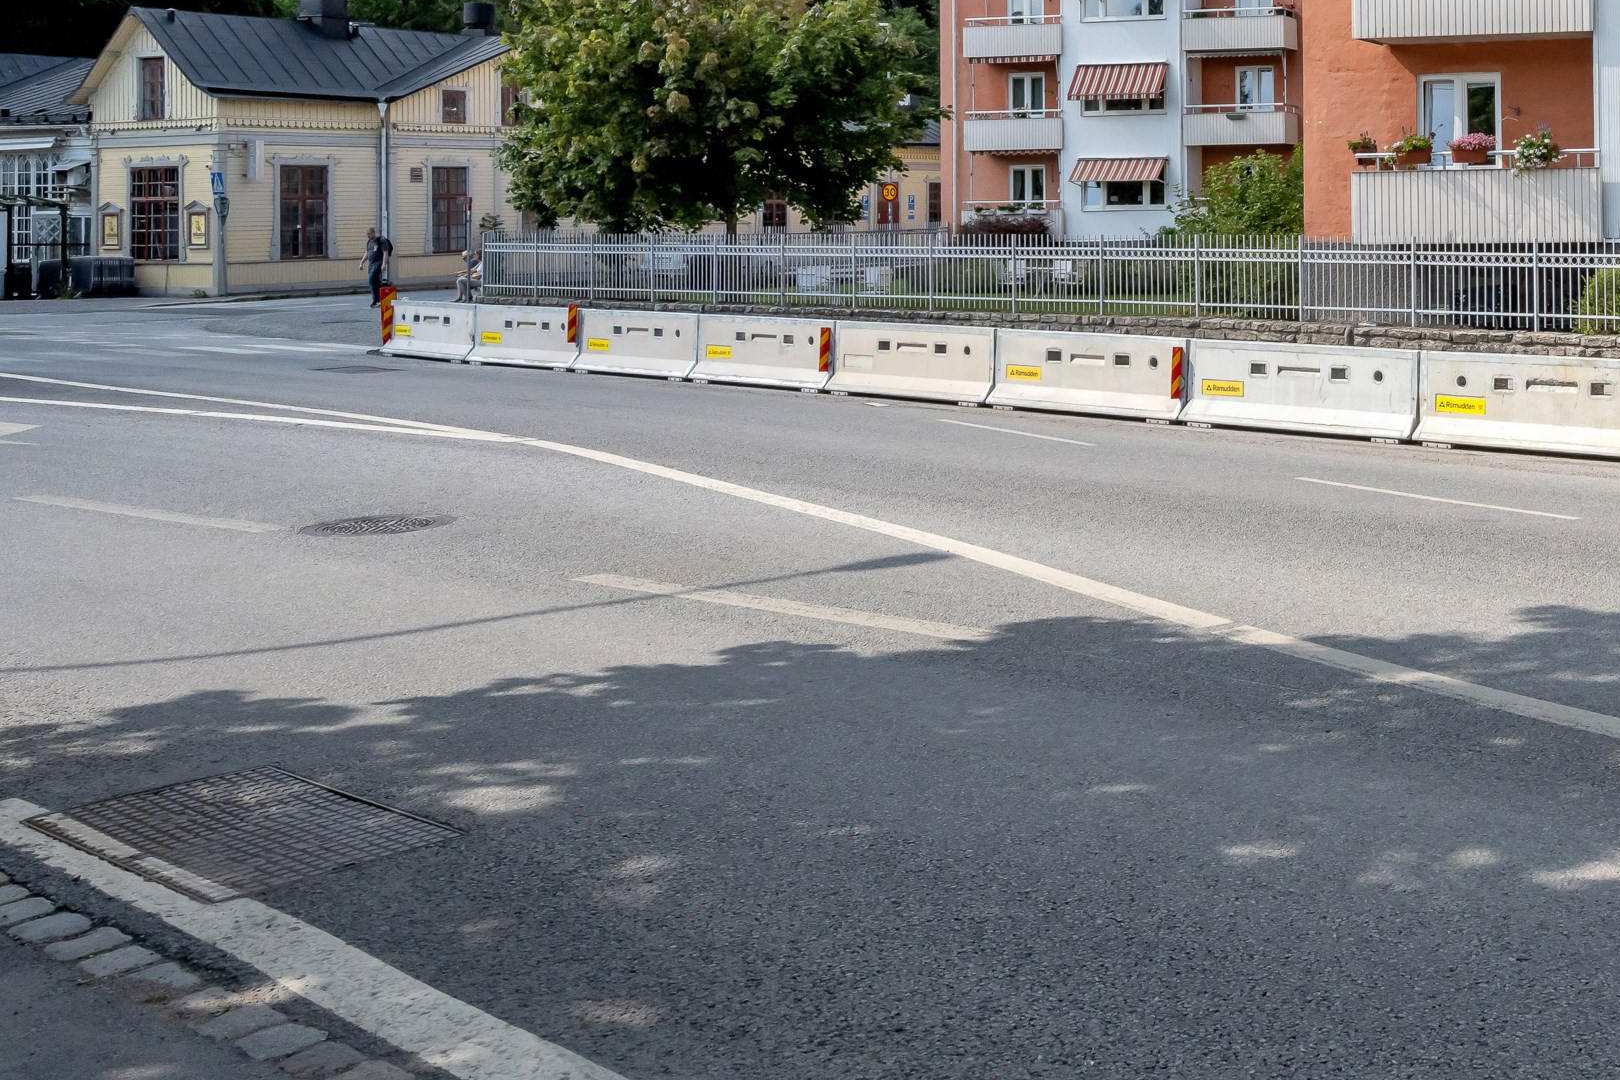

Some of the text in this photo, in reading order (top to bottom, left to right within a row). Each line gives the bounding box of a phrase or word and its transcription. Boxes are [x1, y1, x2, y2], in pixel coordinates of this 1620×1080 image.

[884, 187, 896, 197] 30
[1212, 384, 1241, 392] Ramudden
[1445, 401, 1476, 410] Ramudden
